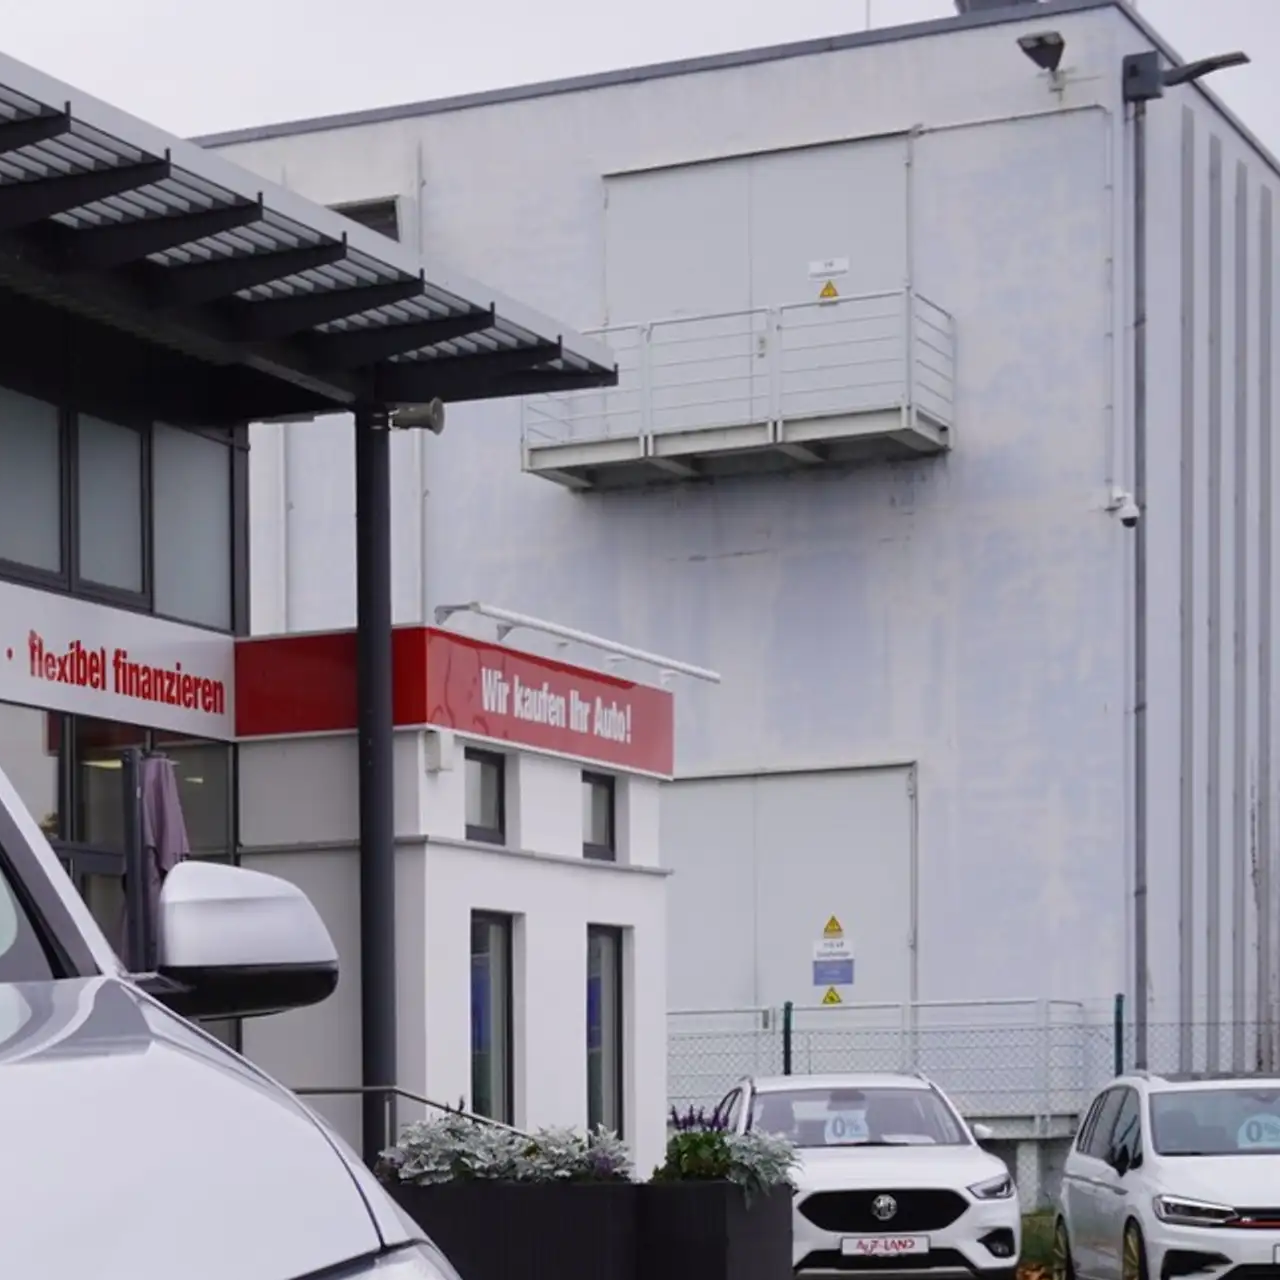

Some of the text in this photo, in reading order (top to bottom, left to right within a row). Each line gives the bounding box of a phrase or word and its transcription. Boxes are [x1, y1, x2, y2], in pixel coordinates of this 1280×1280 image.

[28, 630, 106, 691] flexibel
[112, 648, 225, 714] finanzieren
[481, 667, 632, 744] Wir kaufen Ihr Auto!
